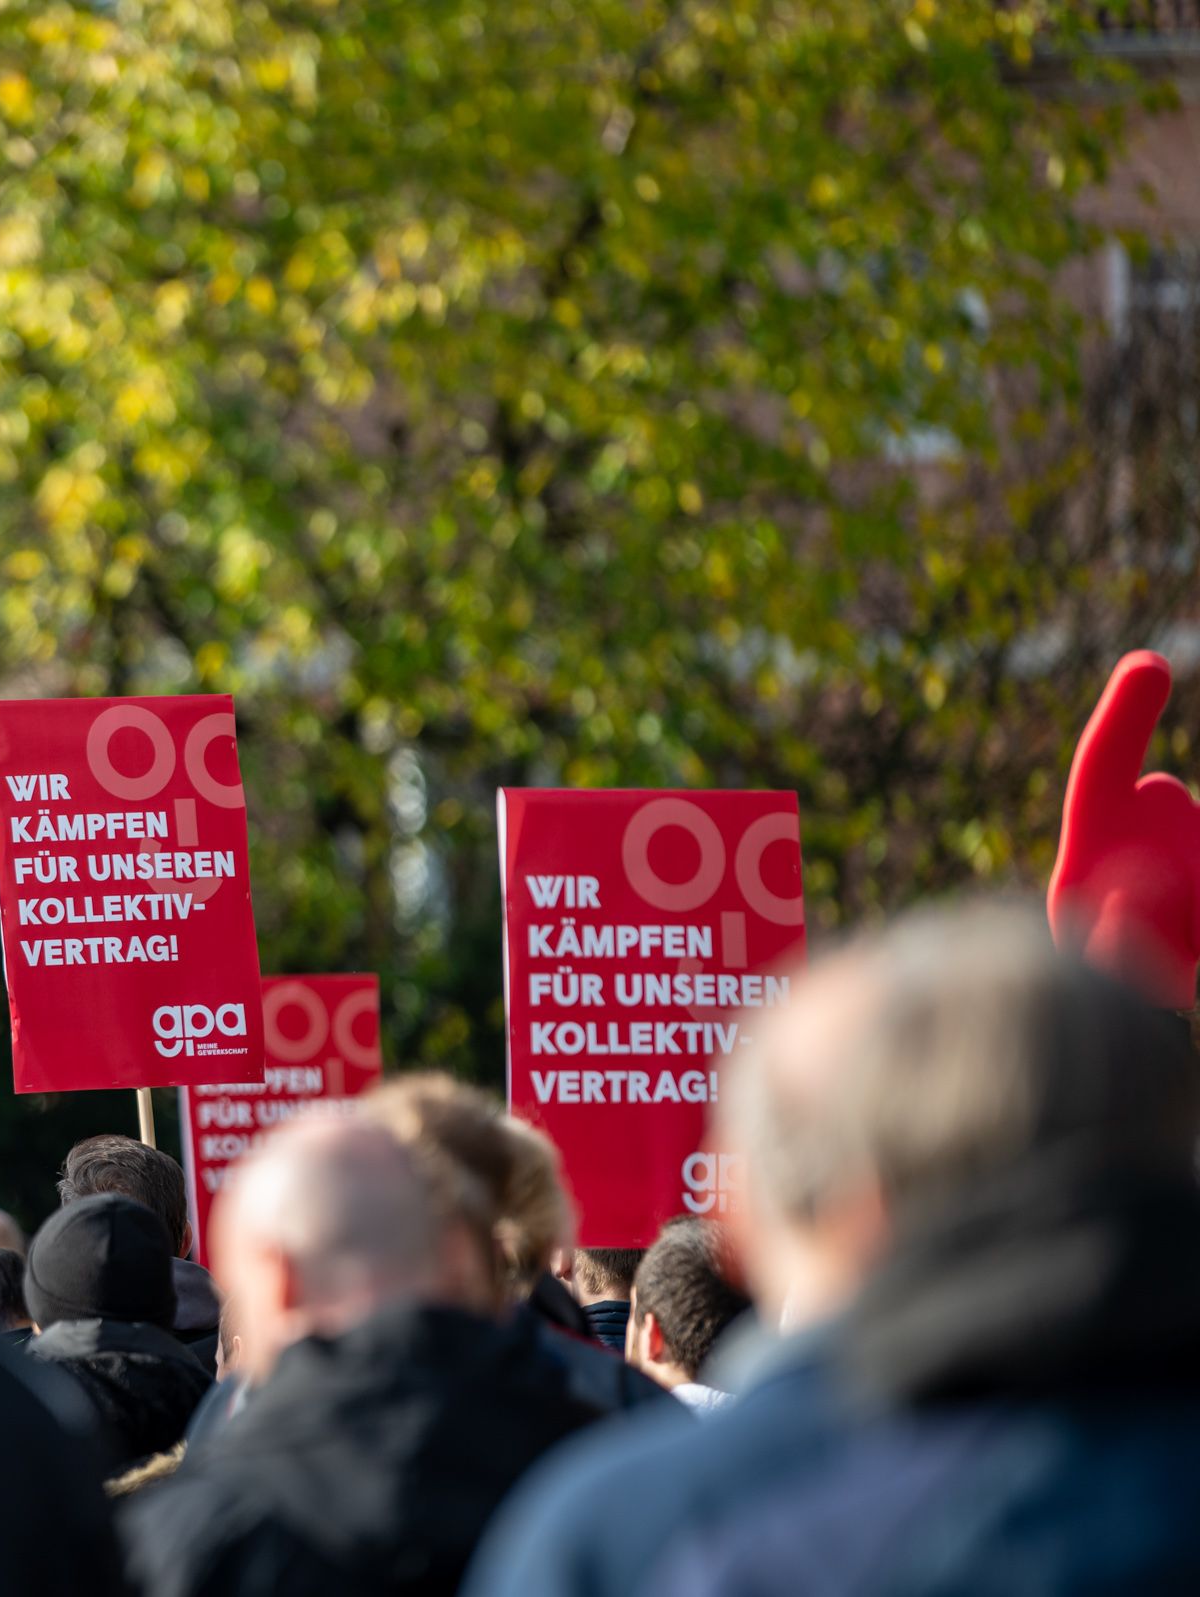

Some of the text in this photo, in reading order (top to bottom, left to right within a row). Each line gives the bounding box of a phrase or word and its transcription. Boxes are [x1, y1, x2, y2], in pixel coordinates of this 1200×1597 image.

[6, 773, 71, 802] WIR
[11, 809, 169, 843] KÄMPFEN
[14, 850, 236, 884] FÜR UNSEREN
[526, 875, 601, 908] WIR
[18, 892, 206, 926] KOLLEKTIV-
[21, 934, 179, 967] VERTRAG!
[527, 918, 713, 958] KÄMPFEN
[528, 966, 791, 1007] FÜR UNSEREN
[152, 1003, 247, 1058] gpa
[531, 1022, 753, 1054] KOLLEKTIV-
[197, 1048, 248, 1056] GEWERKSCHAFT
[530, 1071, 718, 1103] VERTRAG!
[196, 1097, 253, 1128] FÜR
[681, 1151, 746, 1214] gp
